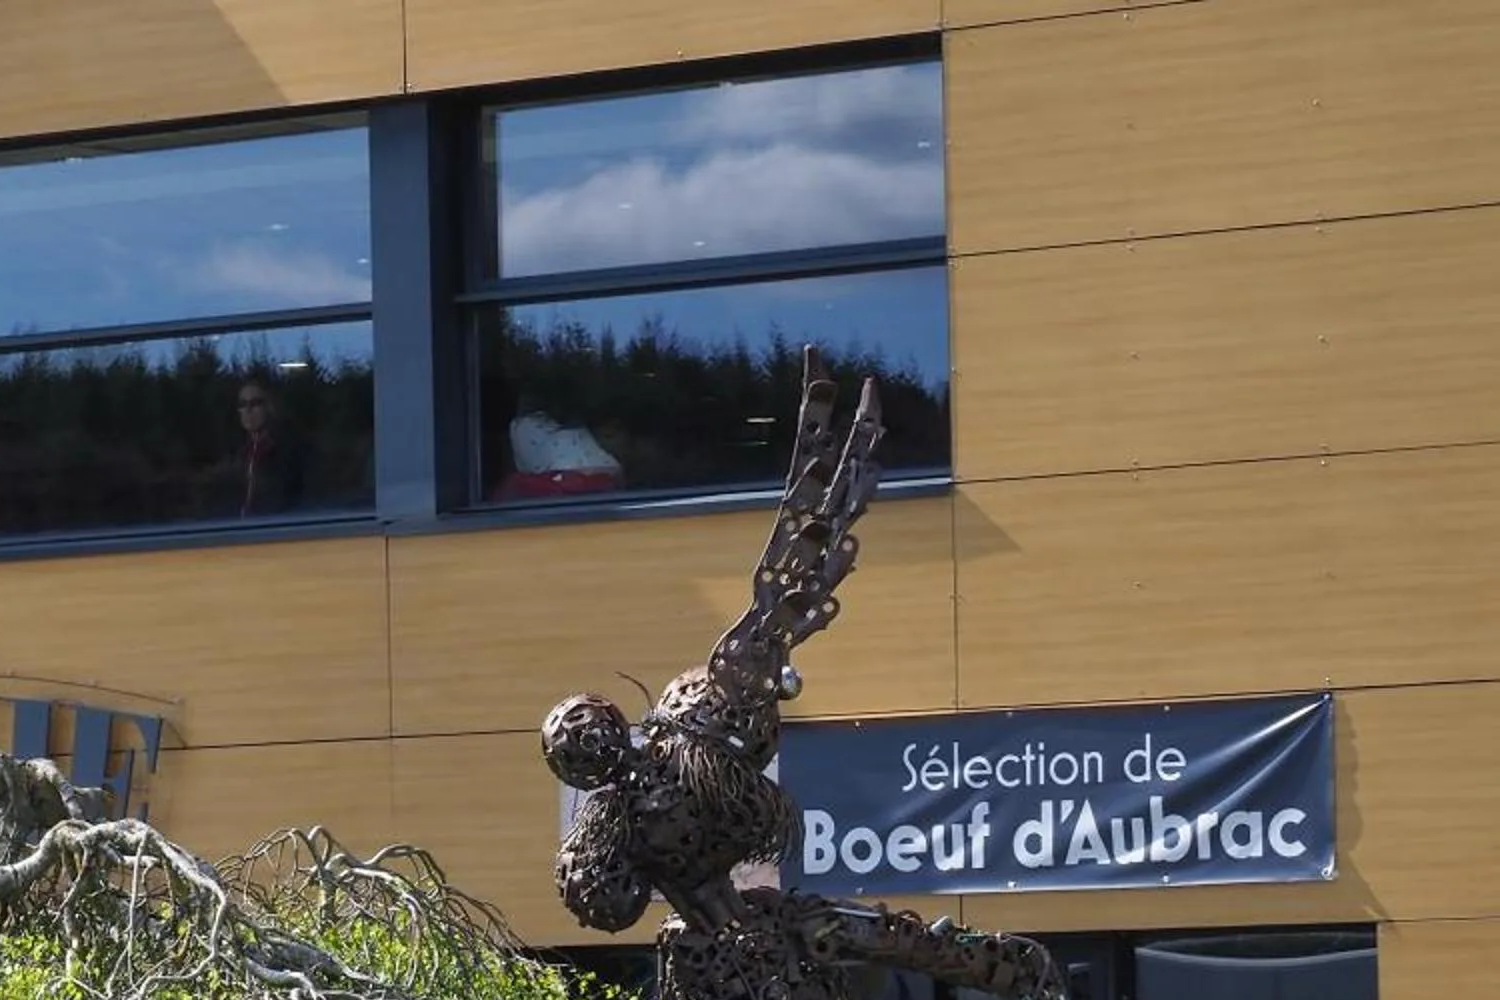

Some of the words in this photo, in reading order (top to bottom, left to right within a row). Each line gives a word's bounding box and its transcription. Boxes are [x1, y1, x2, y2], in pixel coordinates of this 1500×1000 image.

[902, 740, 1103, 793] Sélection
[1123, 732, 1188, 784] de
[803, 801, 992, 875] Boeuf
[1013, 795, 1308, 867] d'Aubrac
